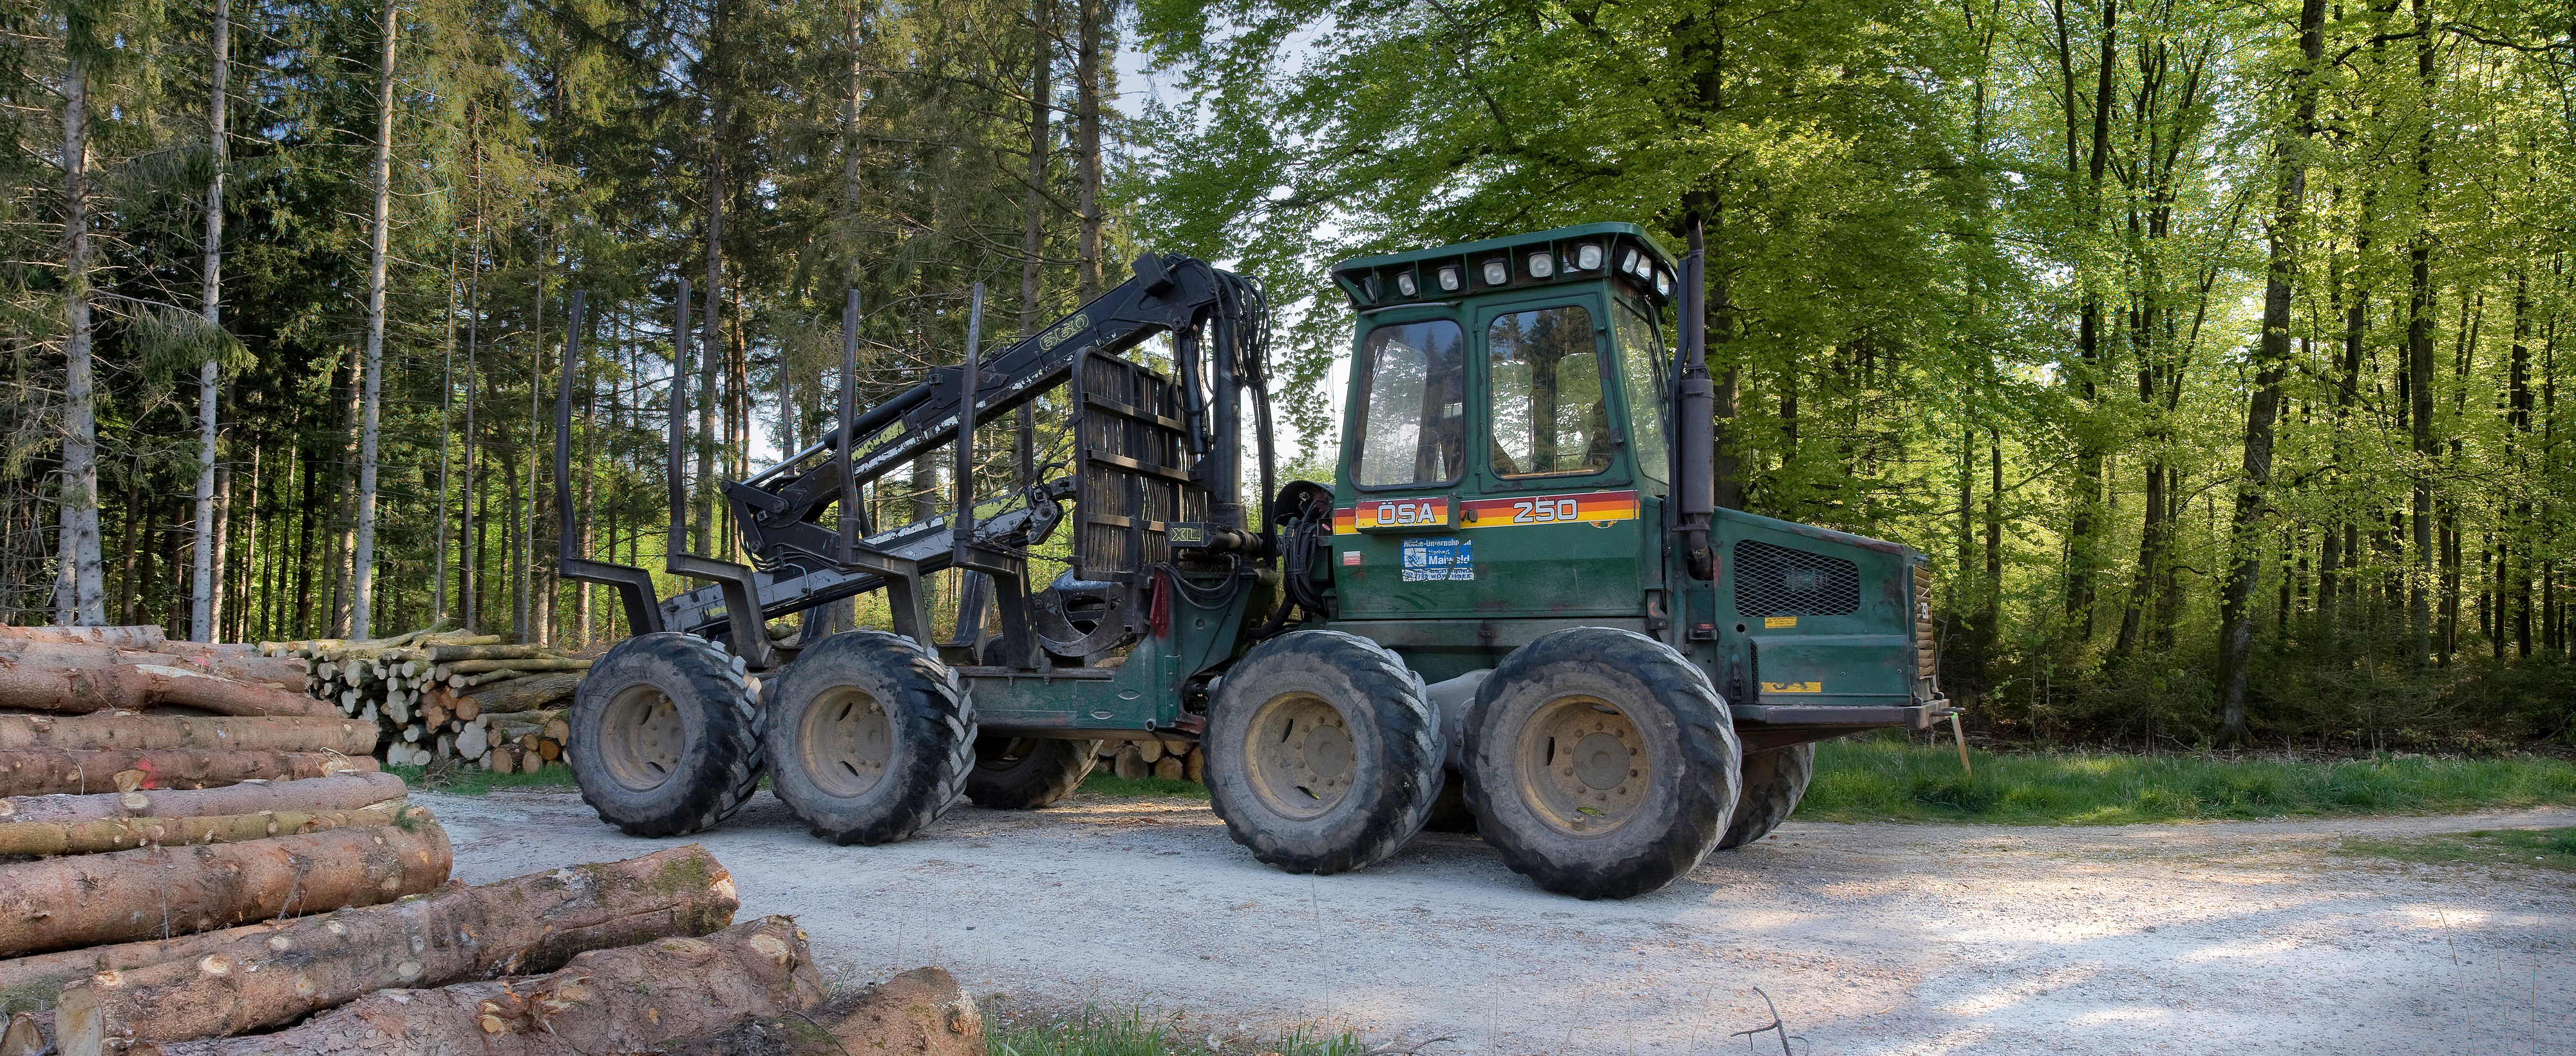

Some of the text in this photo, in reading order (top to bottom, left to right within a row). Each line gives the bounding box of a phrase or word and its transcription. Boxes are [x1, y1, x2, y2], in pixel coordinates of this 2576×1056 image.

[1377, 499, 1578, 525] ÖSA 250
[1170, 528, 1201, 542] XL
